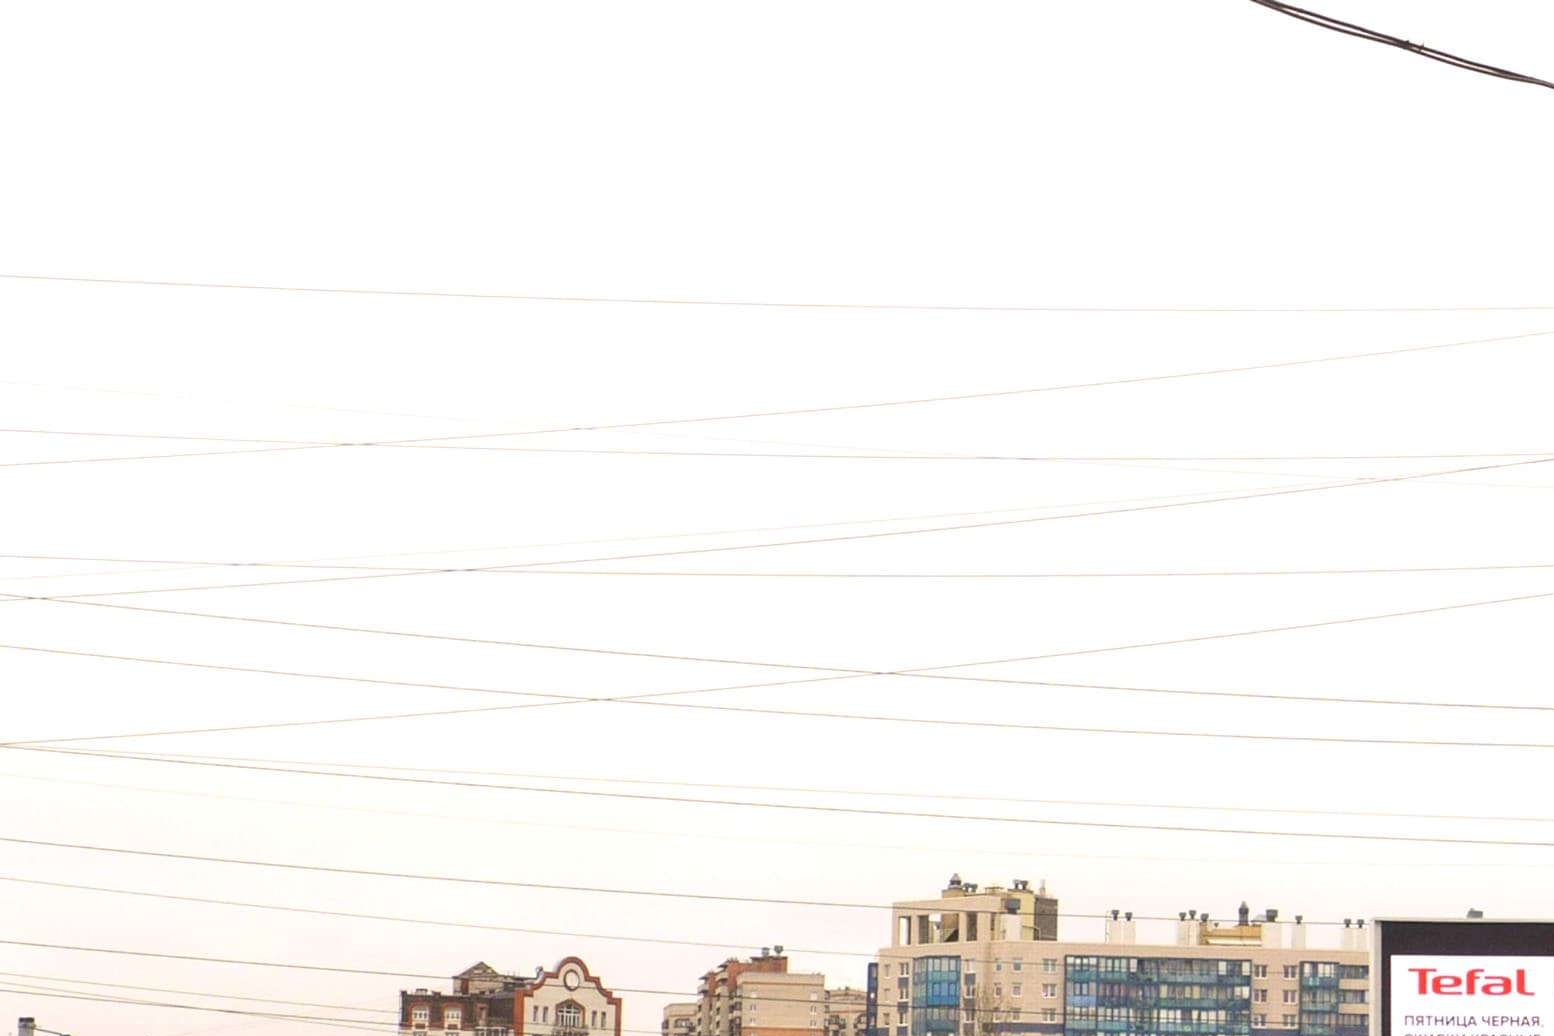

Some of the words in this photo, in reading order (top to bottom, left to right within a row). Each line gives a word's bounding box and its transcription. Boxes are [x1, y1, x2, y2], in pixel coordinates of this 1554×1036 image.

[1408, 968, 1535, 996] Tefal
[1404, 1015, 1477, 1028] ПЯТНИЦА
[1481, 1015, 1544, 1028] ЧЕРНАЯ,
